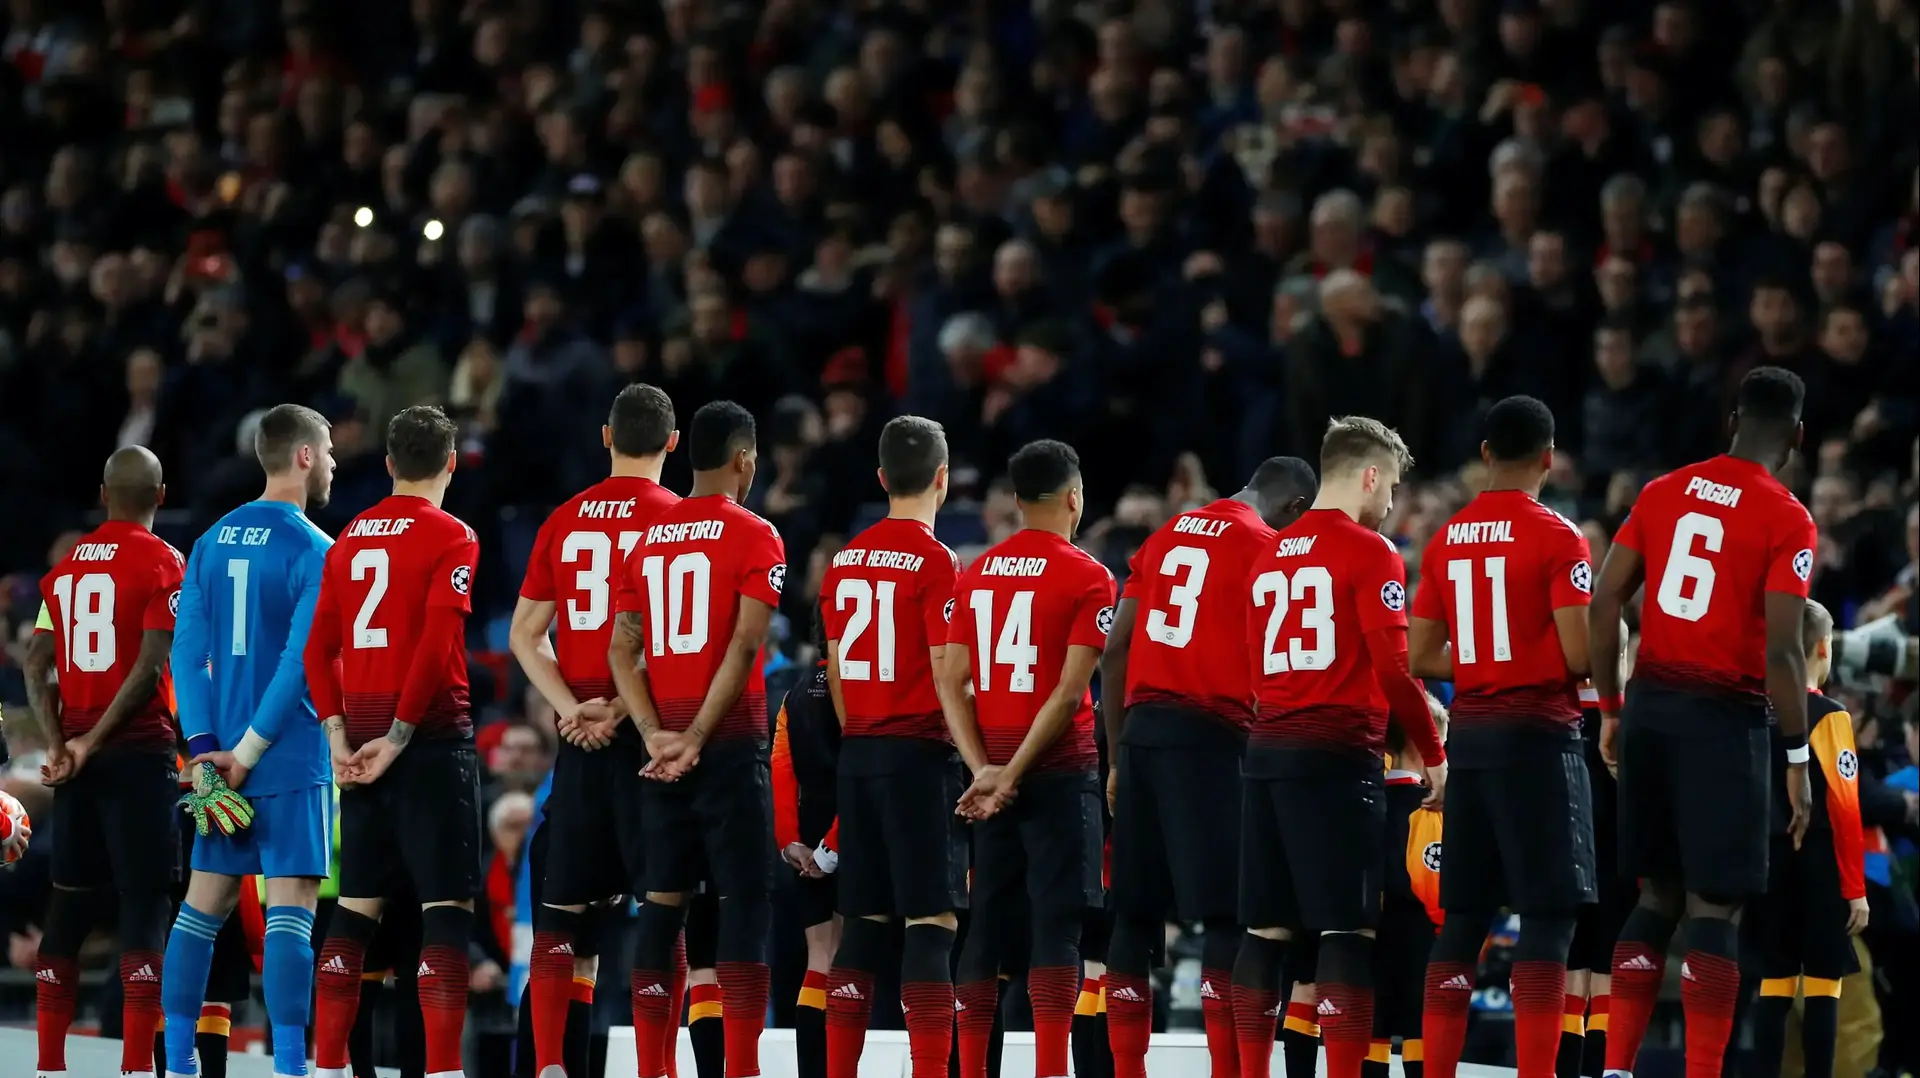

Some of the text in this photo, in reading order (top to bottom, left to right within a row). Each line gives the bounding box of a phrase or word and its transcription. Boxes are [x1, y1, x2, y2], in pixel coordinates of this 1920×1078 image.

[1684, 476, 1742, 508] POGBA
[577, 497, 637, 519] MATIĆ
[217, 526, 272, 546] DE GEA
[346, 518, 415, 538] LINDELOF
[645, 520, 725, 546] RASHFORD
[1173, 515, 1233, 537] BAILLY
[1446, 521, 1514, 545] MARTIAL
[72, 543, 119, 562] YOUNG
[1275, 535, 1317, 558] SHAW
[832, 549, 925, 572] ANDER HERRERA
[981, 556, 1048, 577] LINGARD
[1657, 511, 1724, 622] 6
[227, 558, 250, 656] 1
[350, 548, 390, 649] 2
[642, 552, 711, 656] 10
[1146, 546, 1210, 649] 3
[53, 573, 116, 673] 18
[1252, 567, 1336, 676] 23
[1447, 556, 1512, 665] 11
[836, 579, 896, 682] 21
[970, 589, 1038, 693] 14
[129, 974, 158, 982] adidas
[320, 966, 350, 975] adidas
[831, 991, 865, 1000] adidas
